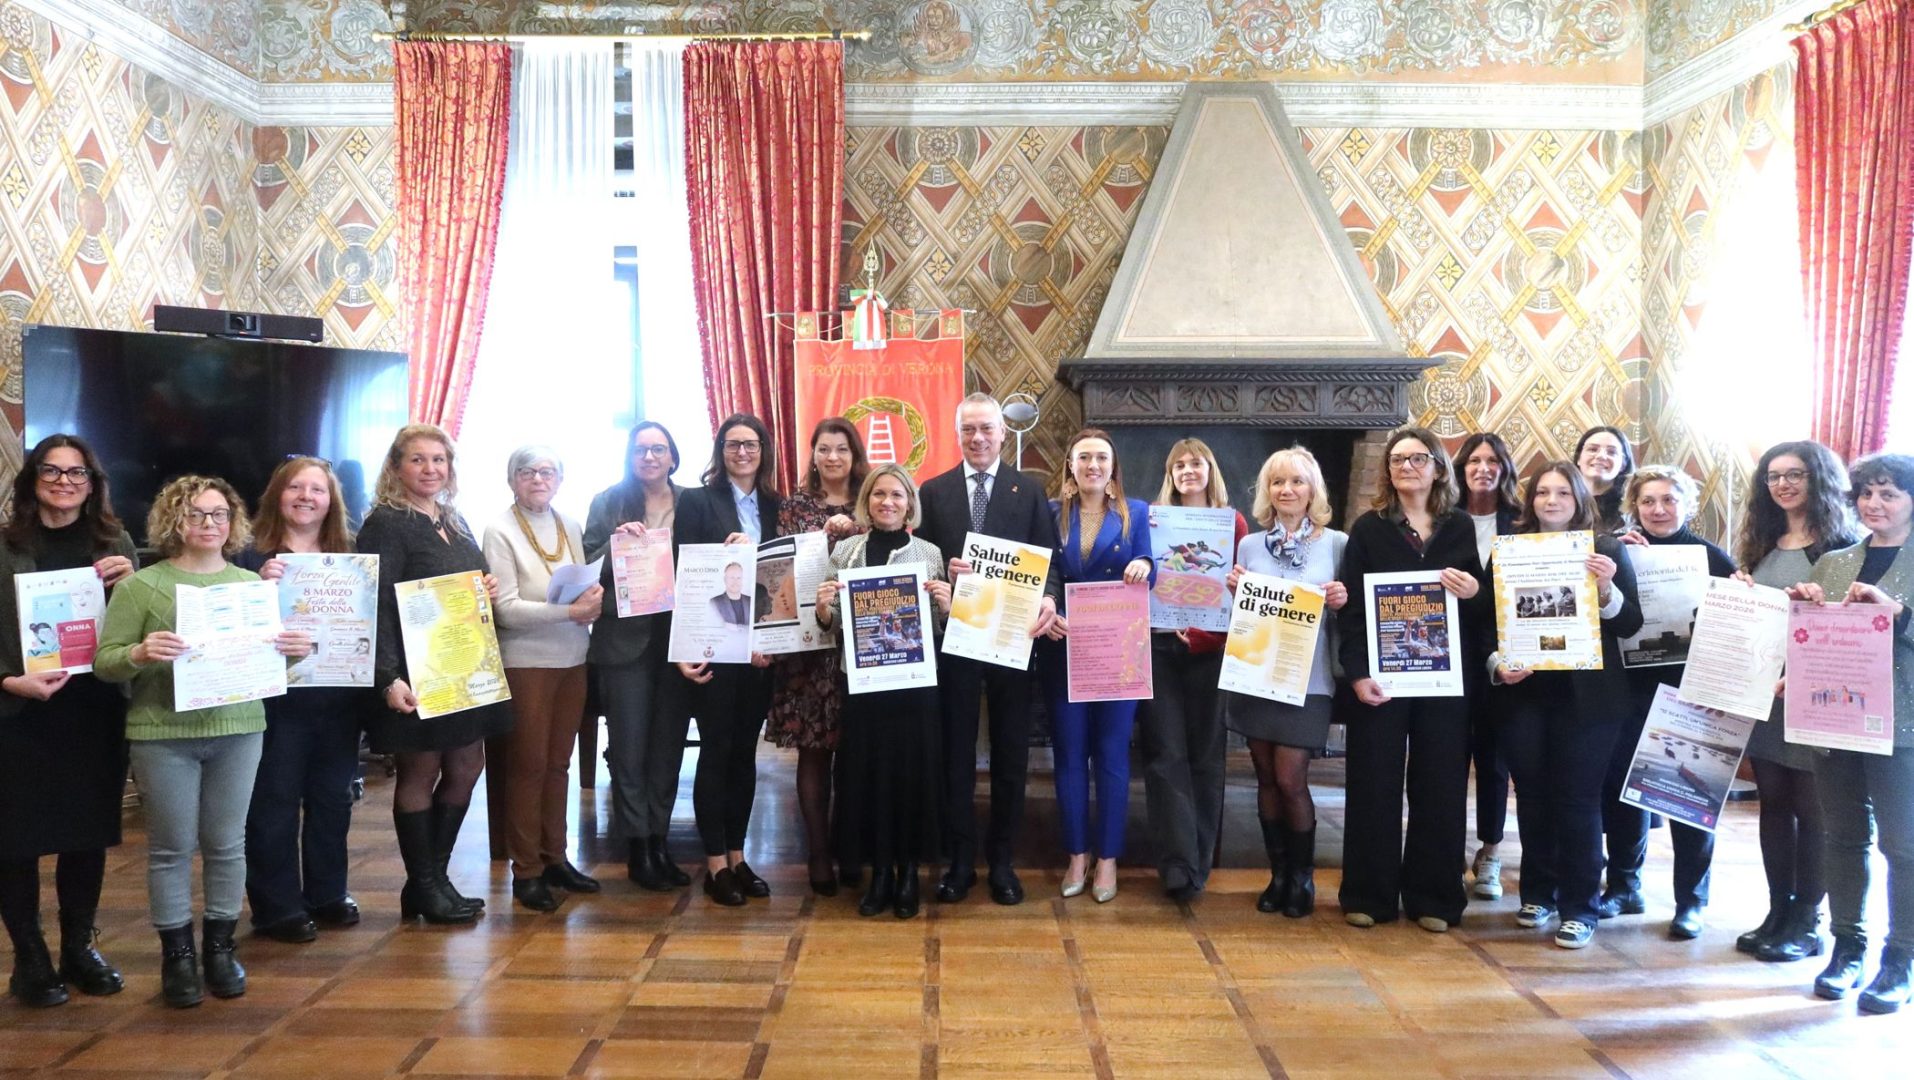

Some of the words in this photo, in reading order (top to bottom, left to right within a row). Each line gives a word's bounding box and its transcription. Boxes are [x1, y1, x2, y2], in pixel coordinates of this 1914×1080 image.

[968, 543, 1021, 566] Salute
[985, 565, 1041, 586] genere
[303, 587, 311, 596] 8
[314, 588, 353, 597] MARZO
[853, 590, 875, 601] FUORI
[876, 588, 899, 598] GIOCO
[1242, 581, 1295, 604] Salute
[1706, 592, 1727, 601] MESE
[1728, 595, 1756, 606] DELLA
[854, 599, 869, 609] DAL
[870, 595, 916, 607] PREGIUDIZIO
[1378, 595, 1400, 605] FUORI
[1402, 594, 1426, 604] GIOCO
[311, 605, 354, 613] DONNA
[1239, 598, 1256, 612] di
[1259, 603, 1316, 624] genere
[1379, 604, 1394, 613] DAL
[1395, 602, 1444, 613] PREGIUDIZIO
[1704, 600, 1732, 610] MARZO
[1733, 605, 1755, 614] 2026
[65, 623, 91, 632] ONNA
